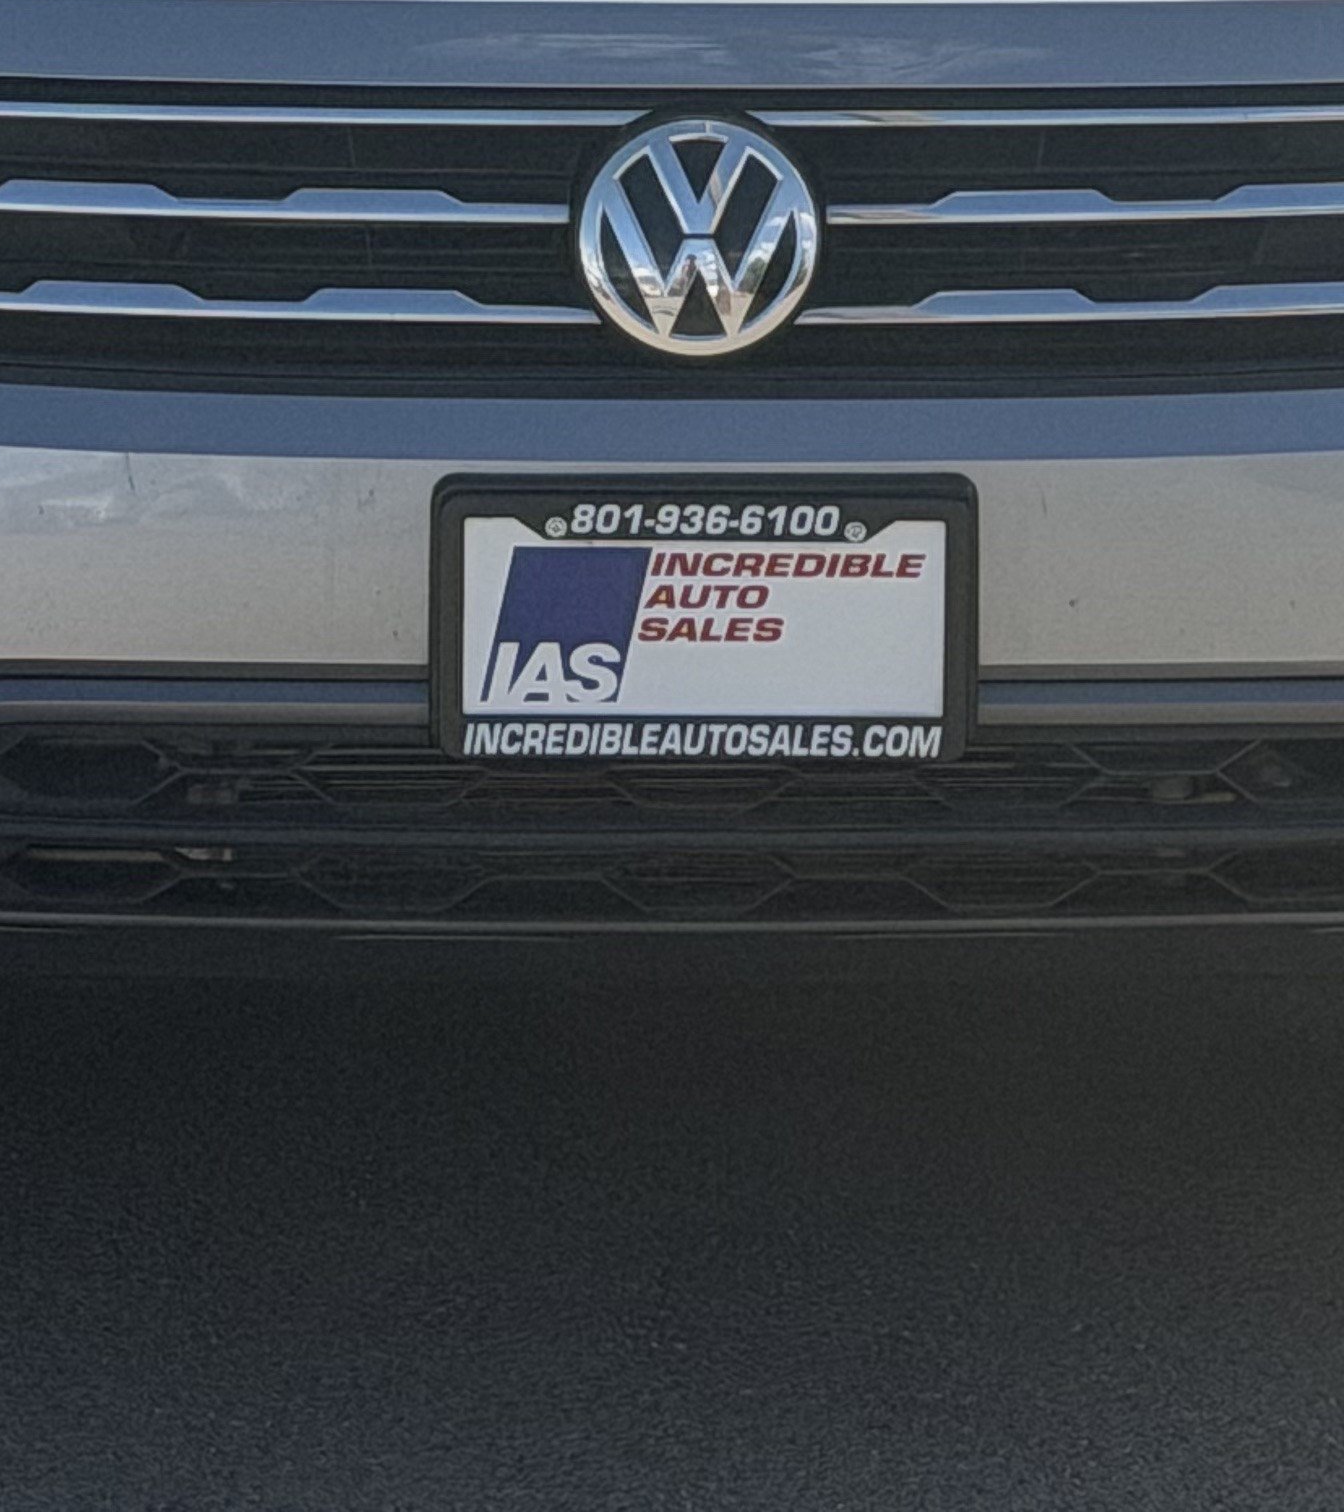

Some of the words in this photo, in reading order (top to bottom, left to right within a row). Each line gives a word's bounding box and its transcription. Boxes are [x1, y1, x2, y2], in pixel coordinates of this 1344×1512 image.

[570, 503, 841, 538] 801-936-6100
[650, 552, 926, 579] INCREDIBLE
[644, 584, 770, 610] AUTO
[637, 616, 785, 643] SALES
[489, 641, 622, 703] IAS
[462, 721, 943, 758] INCREDIBLEAUTOSALES.COM
